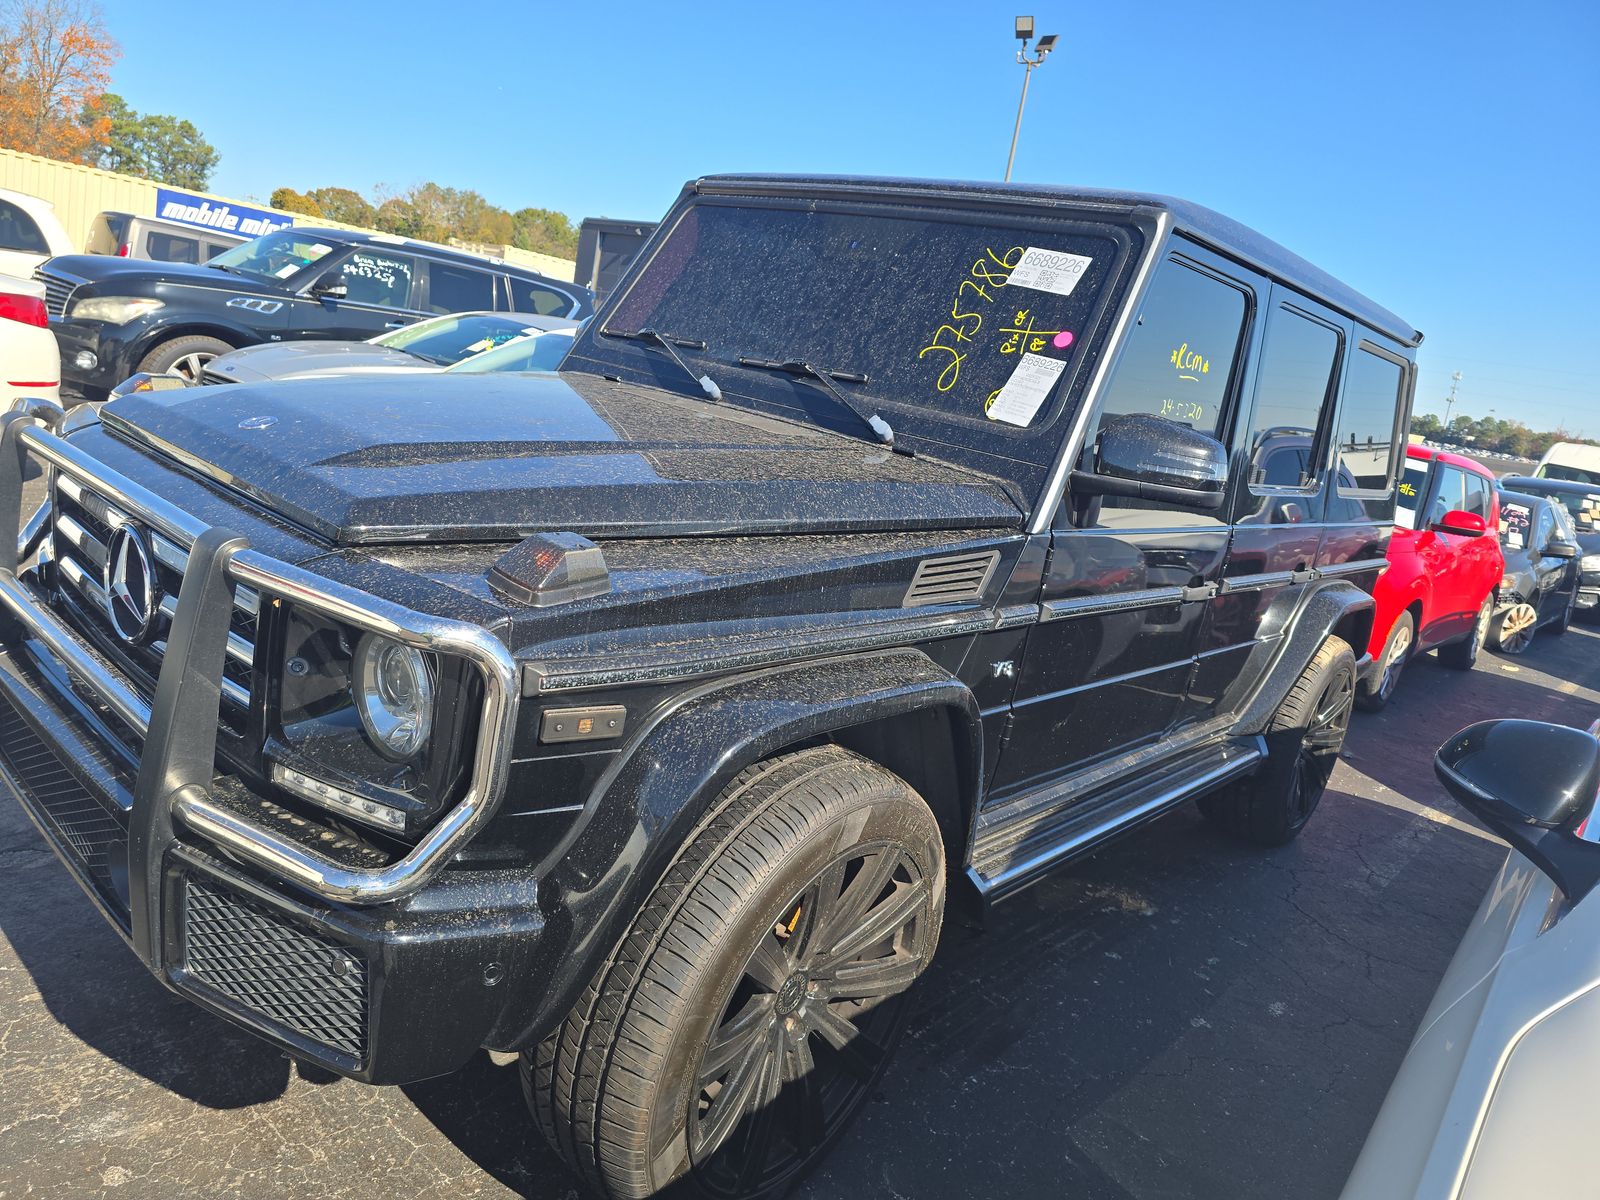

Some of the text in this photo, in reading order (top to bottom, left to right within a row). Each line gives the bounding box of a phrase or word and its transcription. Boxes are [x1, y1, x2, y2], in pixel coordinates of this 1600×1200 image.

[161, 202, 239, 231] mobile
[1024, 251, 1085, 274] 6689226
[919, 246, 1025, 391] 275786
[1021, 354, 1065, 373] 6689226
